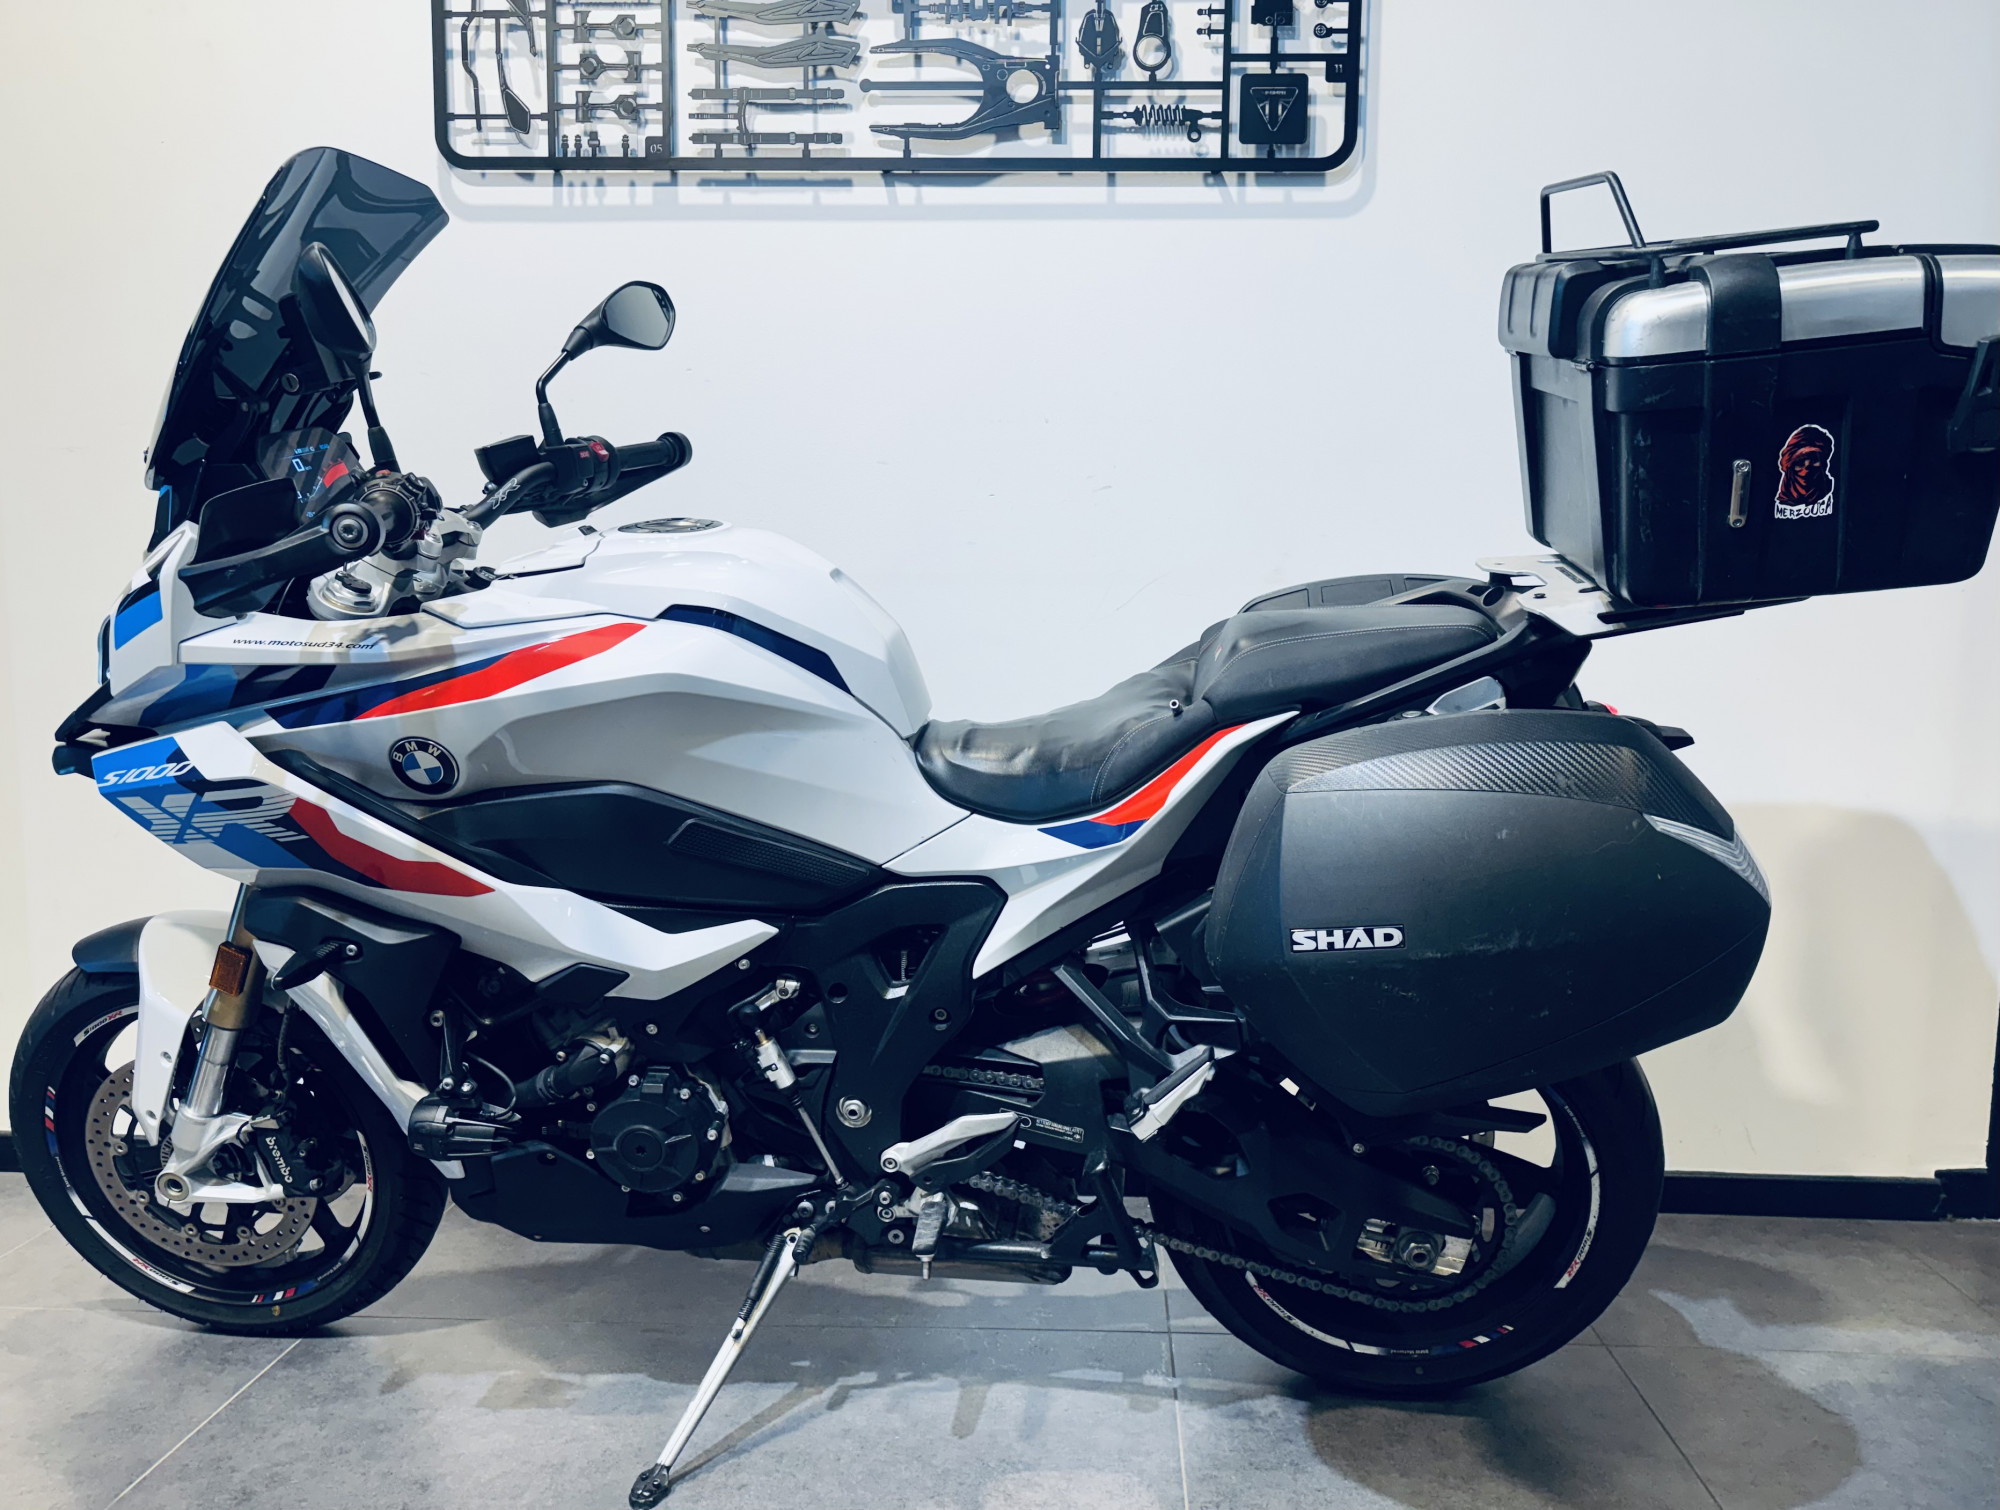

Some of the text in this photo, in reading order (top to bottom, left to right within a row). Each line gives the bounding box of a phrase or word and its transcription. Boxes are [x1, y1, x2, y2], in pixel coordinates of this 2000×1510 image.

[650, 143, 663, 153] 05
[486, 477, 521, 510] XR
[1775, 494, 1833, 518] MERZOUGA
[233, 638, 374, 650] www.motosud34.com
[392, 741, 442, 763] BMW
[98, 760, 195, 787] S1000
[116, 785, 310, 843] XR
[1291, 927, 1403, 951] SHAD
[265, 1136, 293, 1184] brembo
